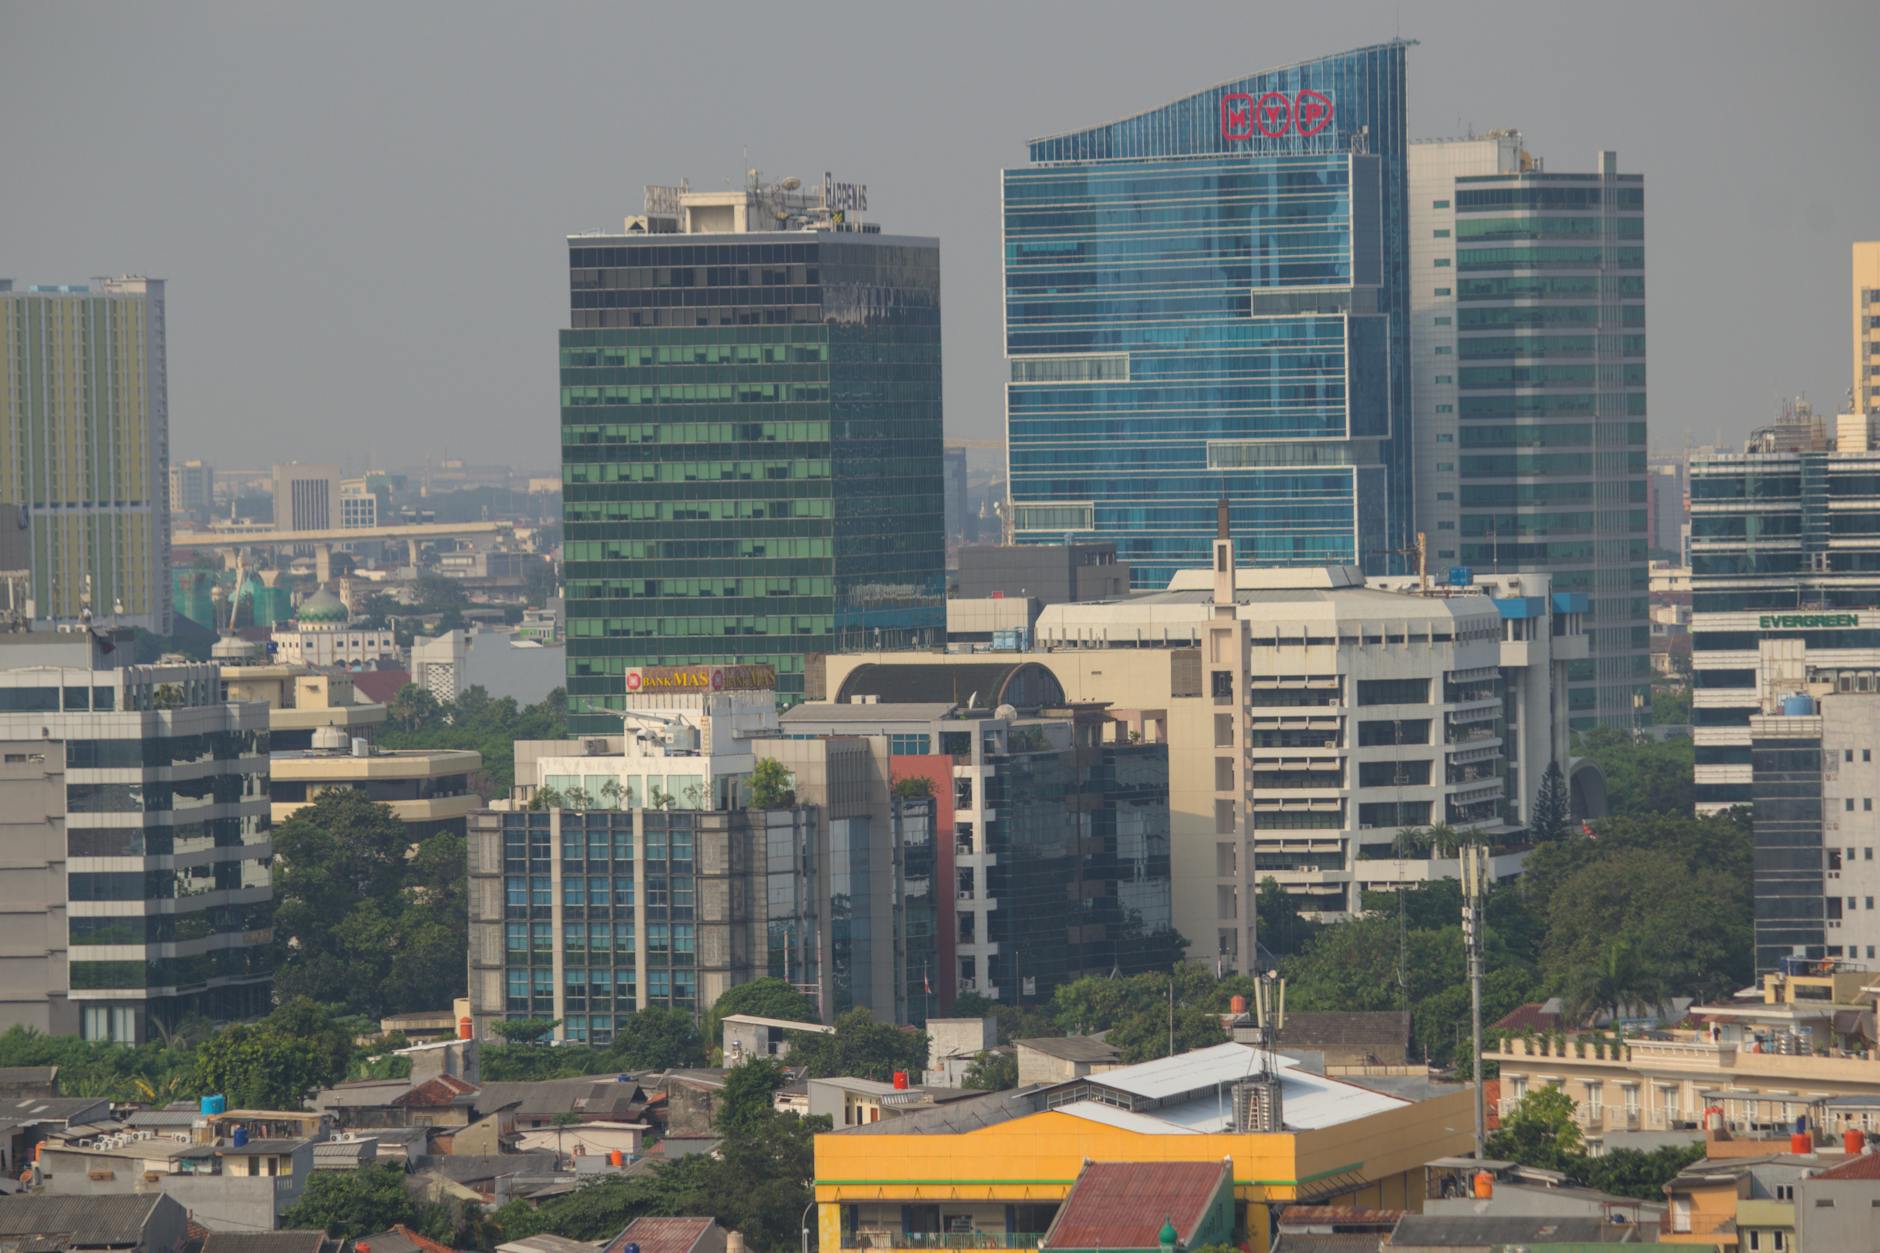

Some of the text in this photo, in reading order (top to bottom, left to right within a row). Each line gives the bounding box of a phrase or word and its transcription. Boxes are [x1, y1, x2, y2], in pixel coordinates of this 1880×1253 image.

[1227, 101, 1326, 131] MYP
[825, 172, 867, 211] BAPPENAS
[1760, 614, 1859, 629] EVERGREEN
[643, 672, 709, 687] BANK MAS
